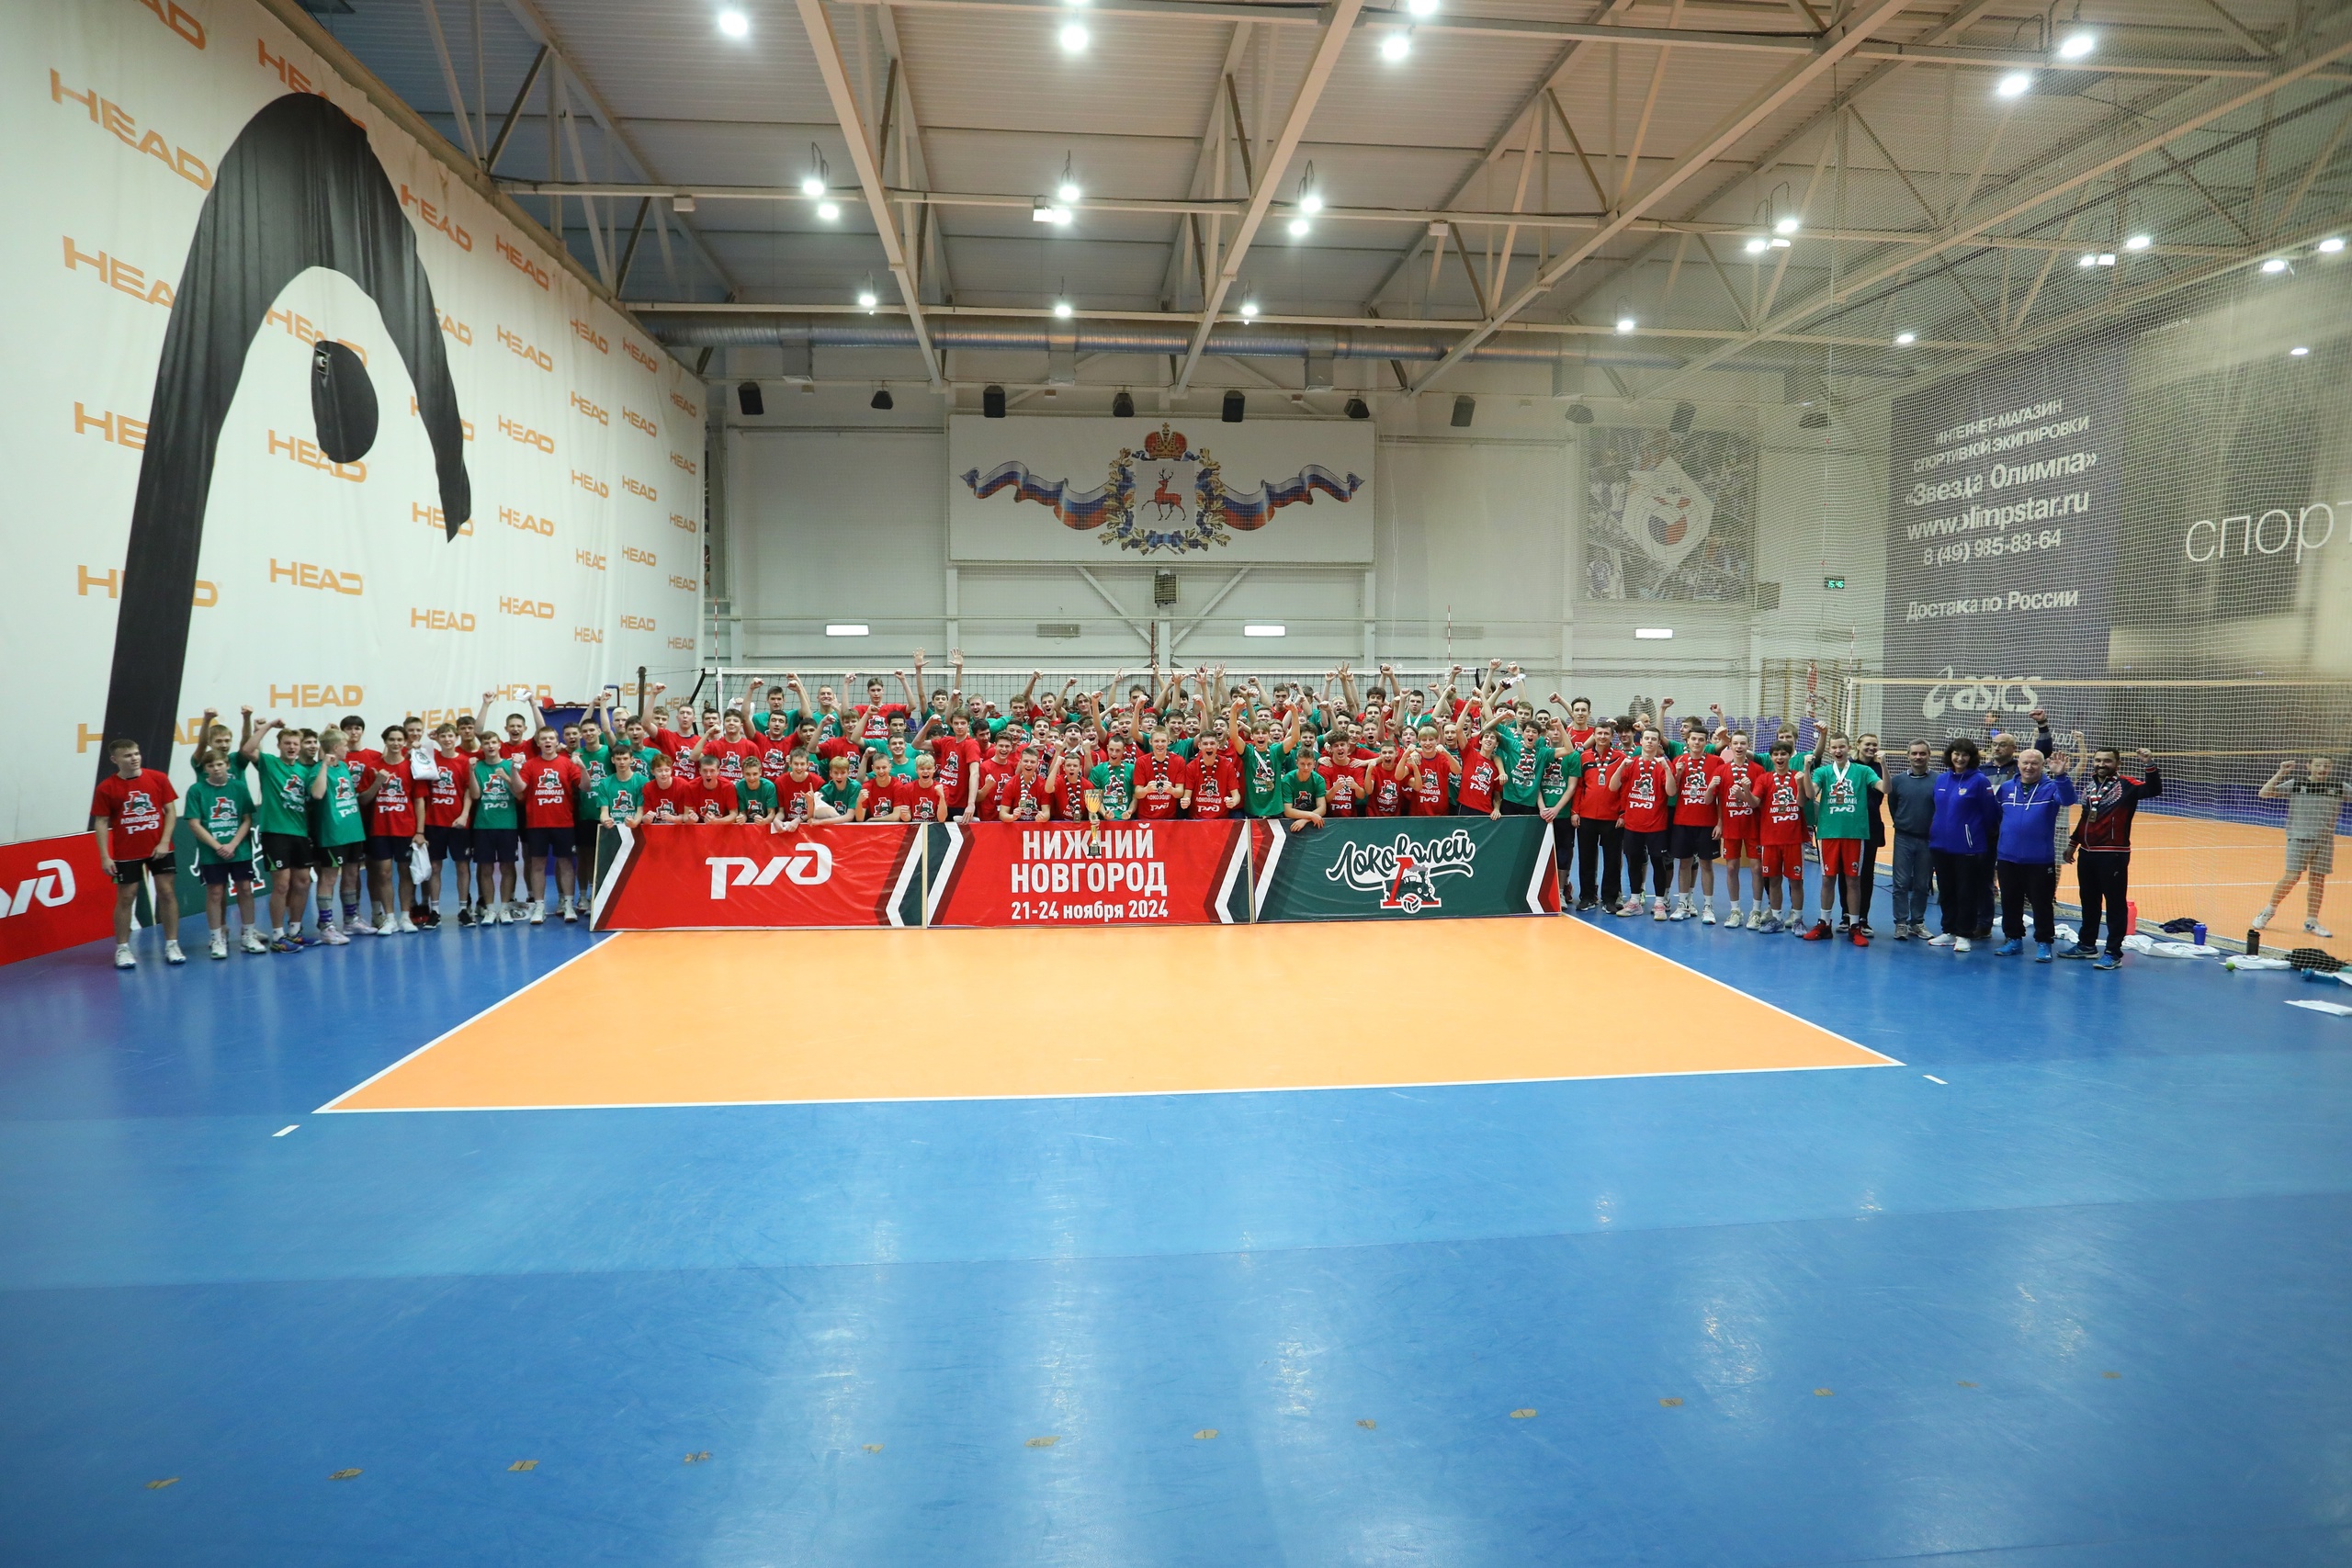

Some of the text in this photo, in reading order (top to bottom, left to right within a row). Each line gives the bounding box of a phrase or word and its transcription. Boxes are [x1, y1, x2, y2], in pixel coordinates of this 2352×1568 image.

[50, 67, 213, 191] HEAD
[401, 183, 472, 253] HEAD
[62, 235, 176, 309] HEA
[496, 234, 548, 291] HEAD
[497, 324, 553, 372] HEAD
[570, 319, 608, 355] HEAD
[623, 337, 657, 374] HEAD
[571, 391, 608, 426] HEAD
[670, 389, 696, 418] HEAD
[74, 401, 149, 450] HE
[498, 415, 555, 455] HEAD
[622, 406, 657, 437] HEAD
[671, 450, 696, 475] HEAD
[571, 469, 609, 499] HEAD
[622, 475, 657, 502] HEAD
[412, 502, 474, 536] HED
[499, 505, 554, 536] HEAD
[670, 512, 696, 534] HEAD
[622, 545, 656, 567] HEAD
[270, 558, 363, 595] HEAD
[669, 574, 696, 592] HEAD
[500, 595, 555, 619] HEAD
[2007, 591, 2079, 612] России
[411, 607, 476, 632] HEAD
[620, 615, 655, 631] HEAD
[667, 637, 695, 650] HEAD
[270, 684, 363, 708] HEAD
[1023, 823, 1154, 861] НИЖНИЙ
[337, 856, 344, 864] 3
[705, 842, 833, 900] РЖД
[1012, 862, 1168, 897] НОВГОРОД
[1012, 899, 1169, 922] 21-24 ноября 2024
